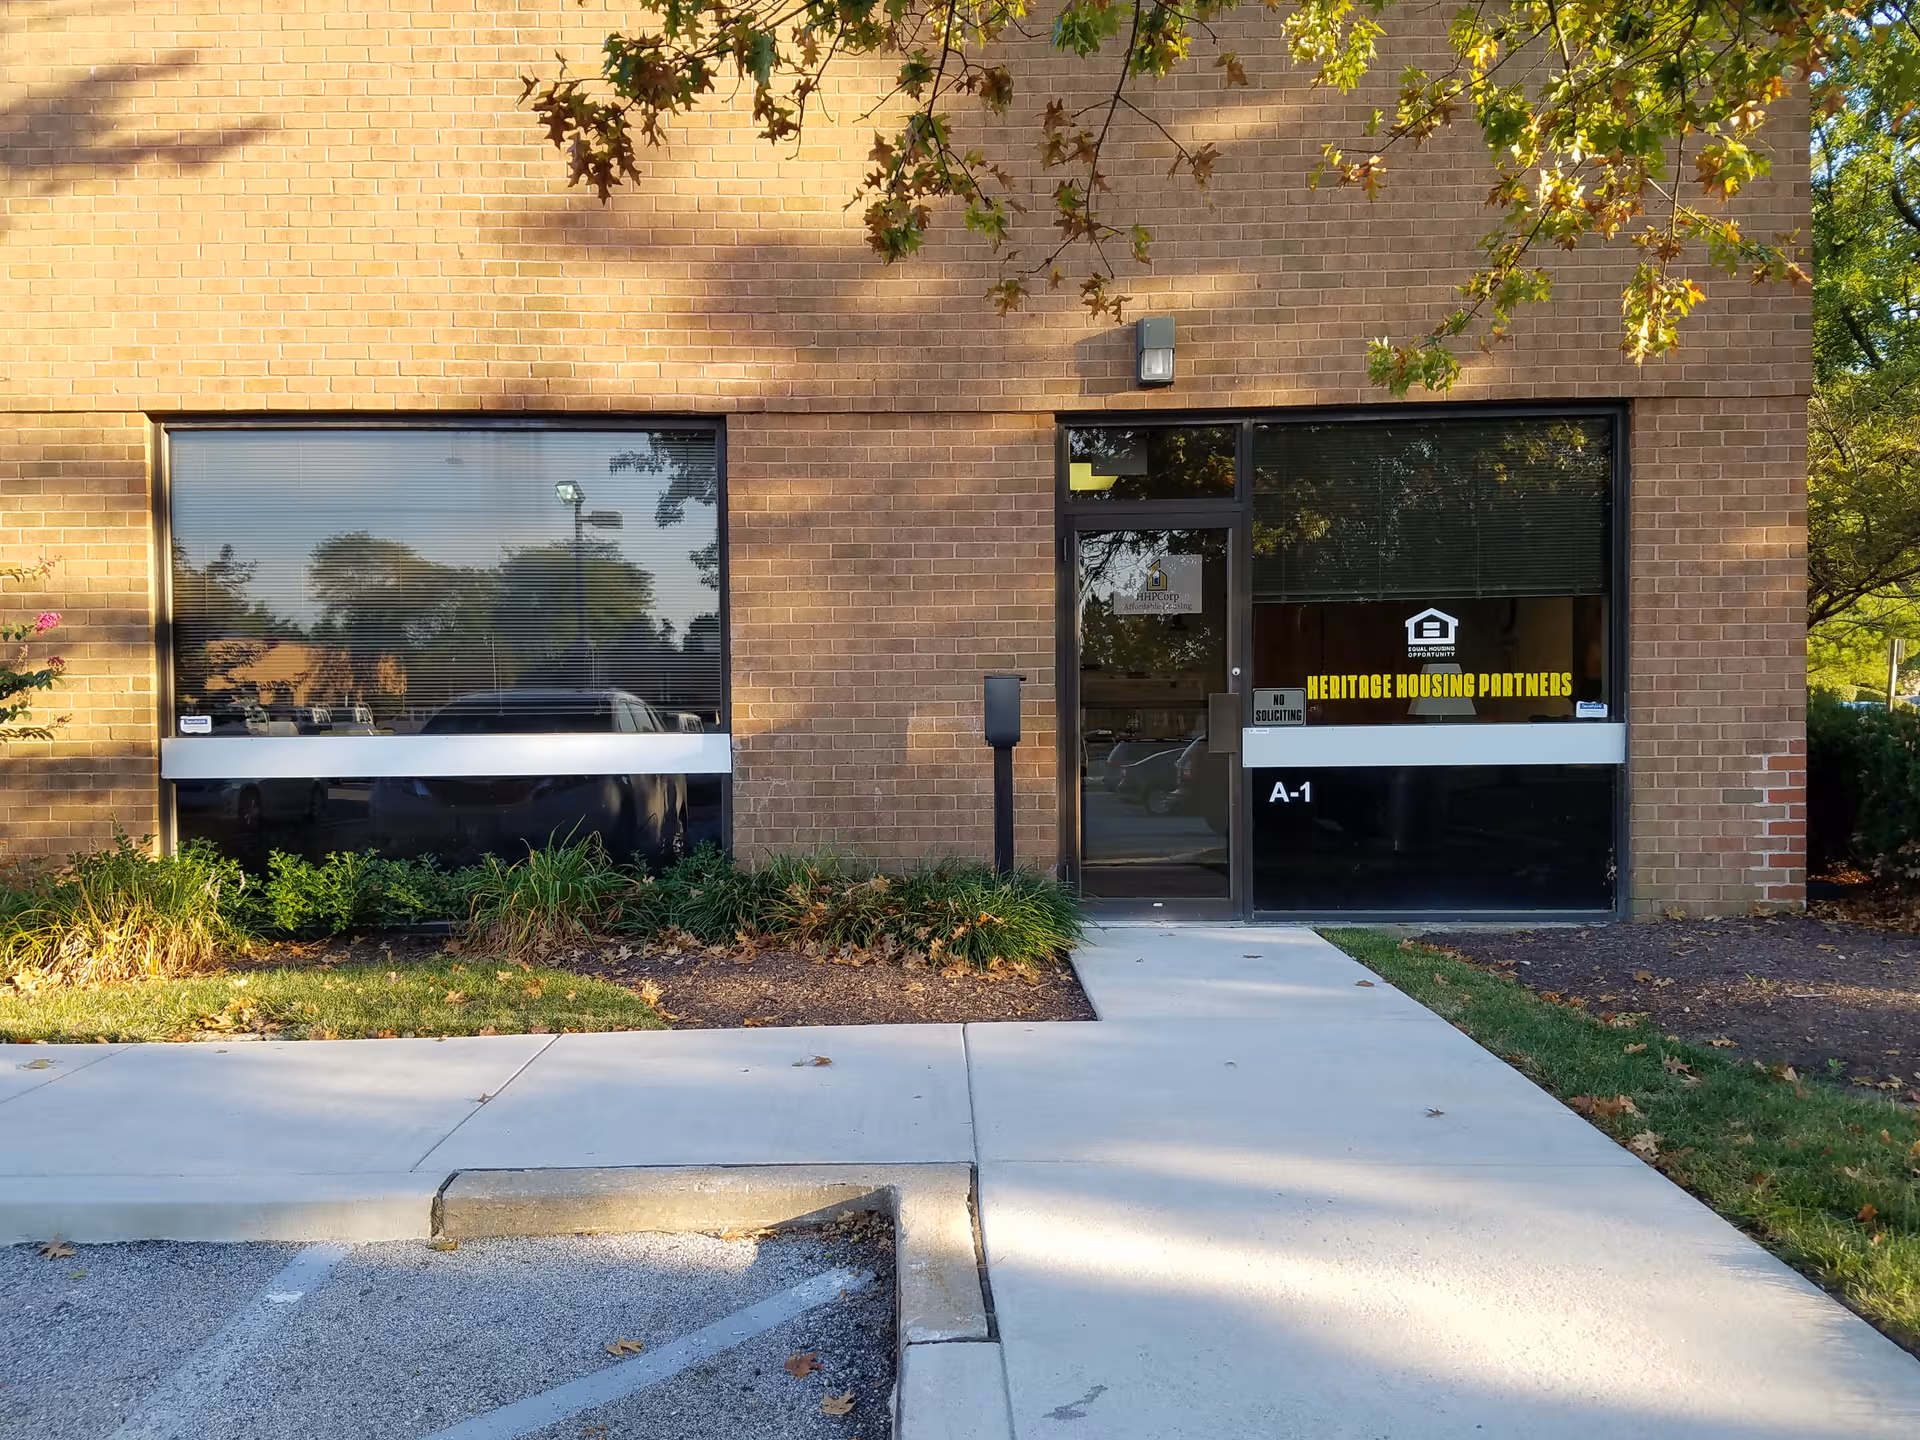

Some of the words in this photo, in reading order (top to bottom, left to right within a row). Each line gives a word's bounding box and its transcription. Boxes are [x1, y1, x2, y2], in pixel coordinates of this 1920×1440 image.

[1136, 592, 1180, 602] HHPCorp
[1123, 602, 1160, 611] Affordable
[1307, 674, 1392, 700] HERITAGE
[1396, 673, 1475, 698] HOUSING
[1478, 672, 1572, 697] PARTNERS
[1273, 694, 1285, 706] NO
[1255, 709, 1302, 722] SOLICITING
[1268, 781, 1311, 803] A-1
